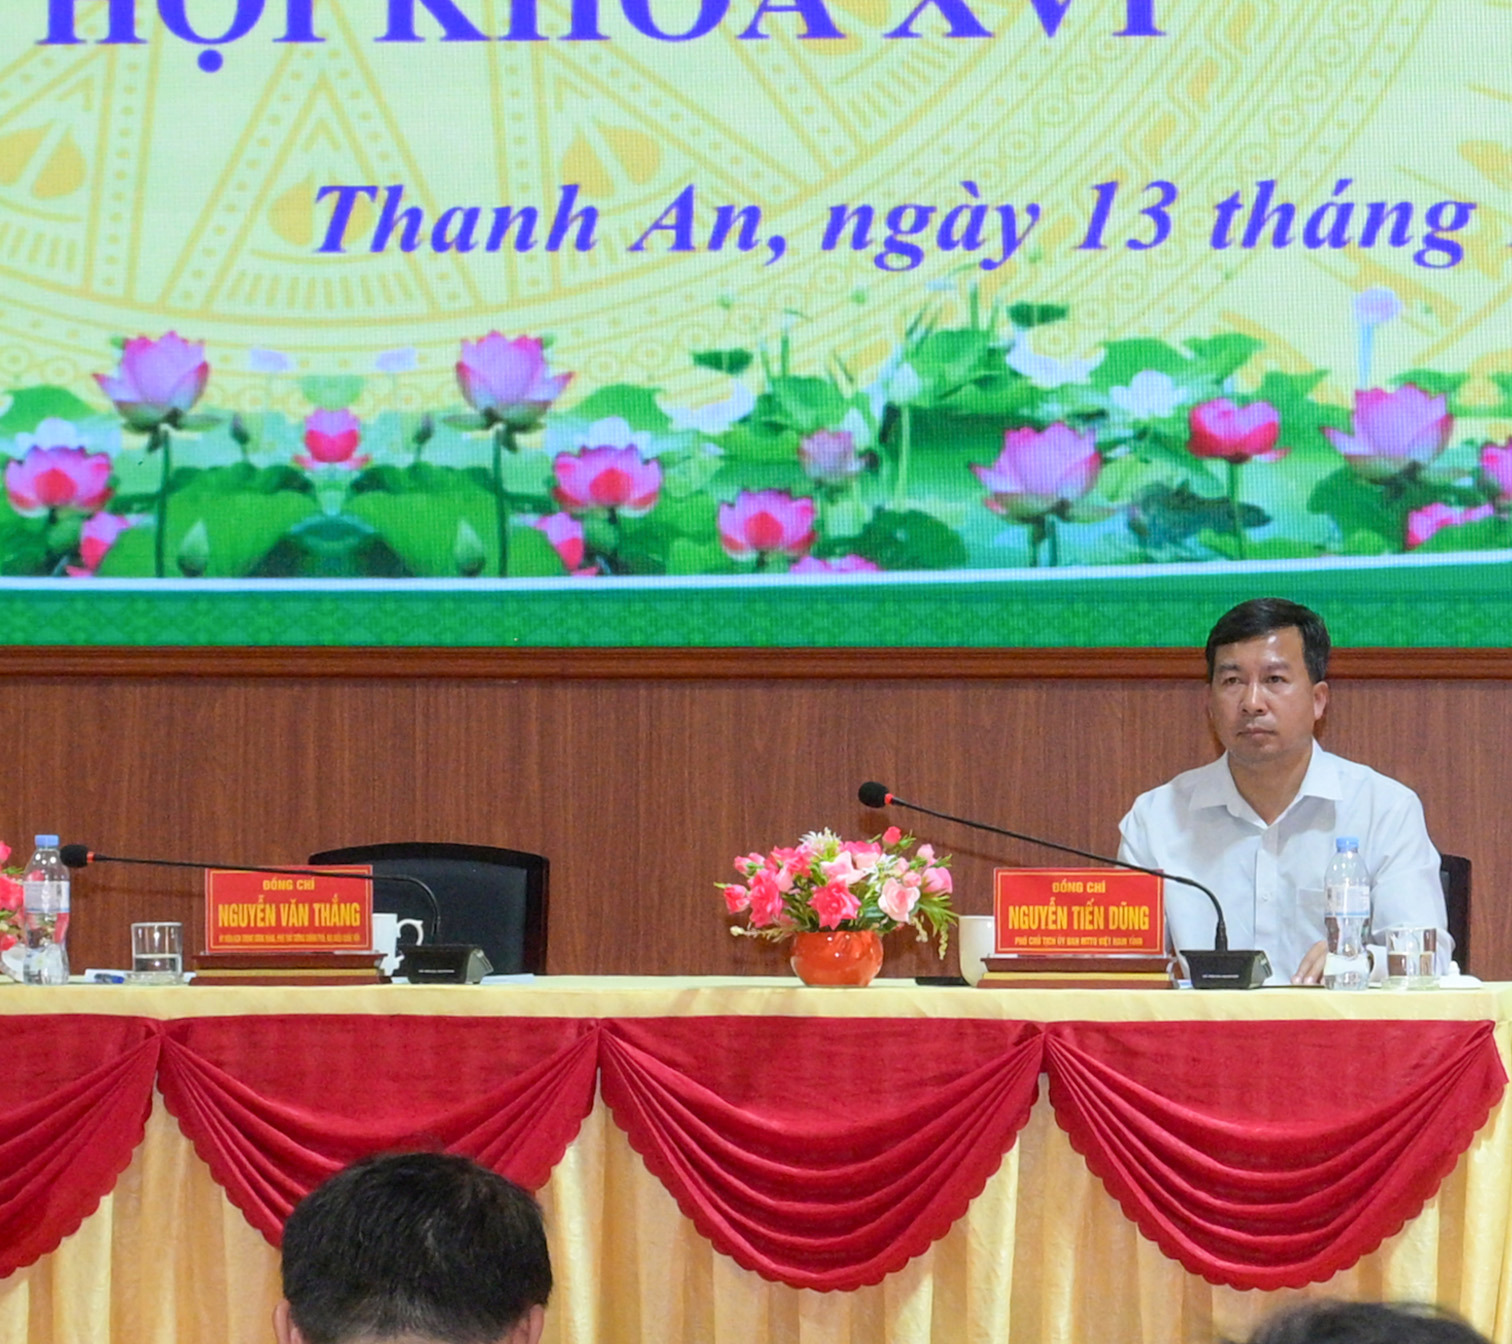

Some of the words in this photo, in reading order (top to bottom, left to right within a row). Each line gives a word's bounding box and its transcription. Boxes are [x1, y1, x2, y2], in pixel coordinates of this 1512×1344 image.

[316, 183, 600, 255] Thanh
[628, 183, 788, 266] An,
[820, 179, 1043, 272] ngày
[1078, 178, 1180, 252] 13
[1209, 177, 1478, 270] tháng
[296, 876, 316, 891] CHÍ
[1086, 880, 1107, 894] CHÍ
[218, 894, 277, 928] NGUYỄN
[280, 897, 309, 928] VĂN
[1008, 896, 1068, 930] NGUYỄN
[1072, 897, 1105, 930] TIẾN
[1108, 901, 1149, 931] DŨNG
